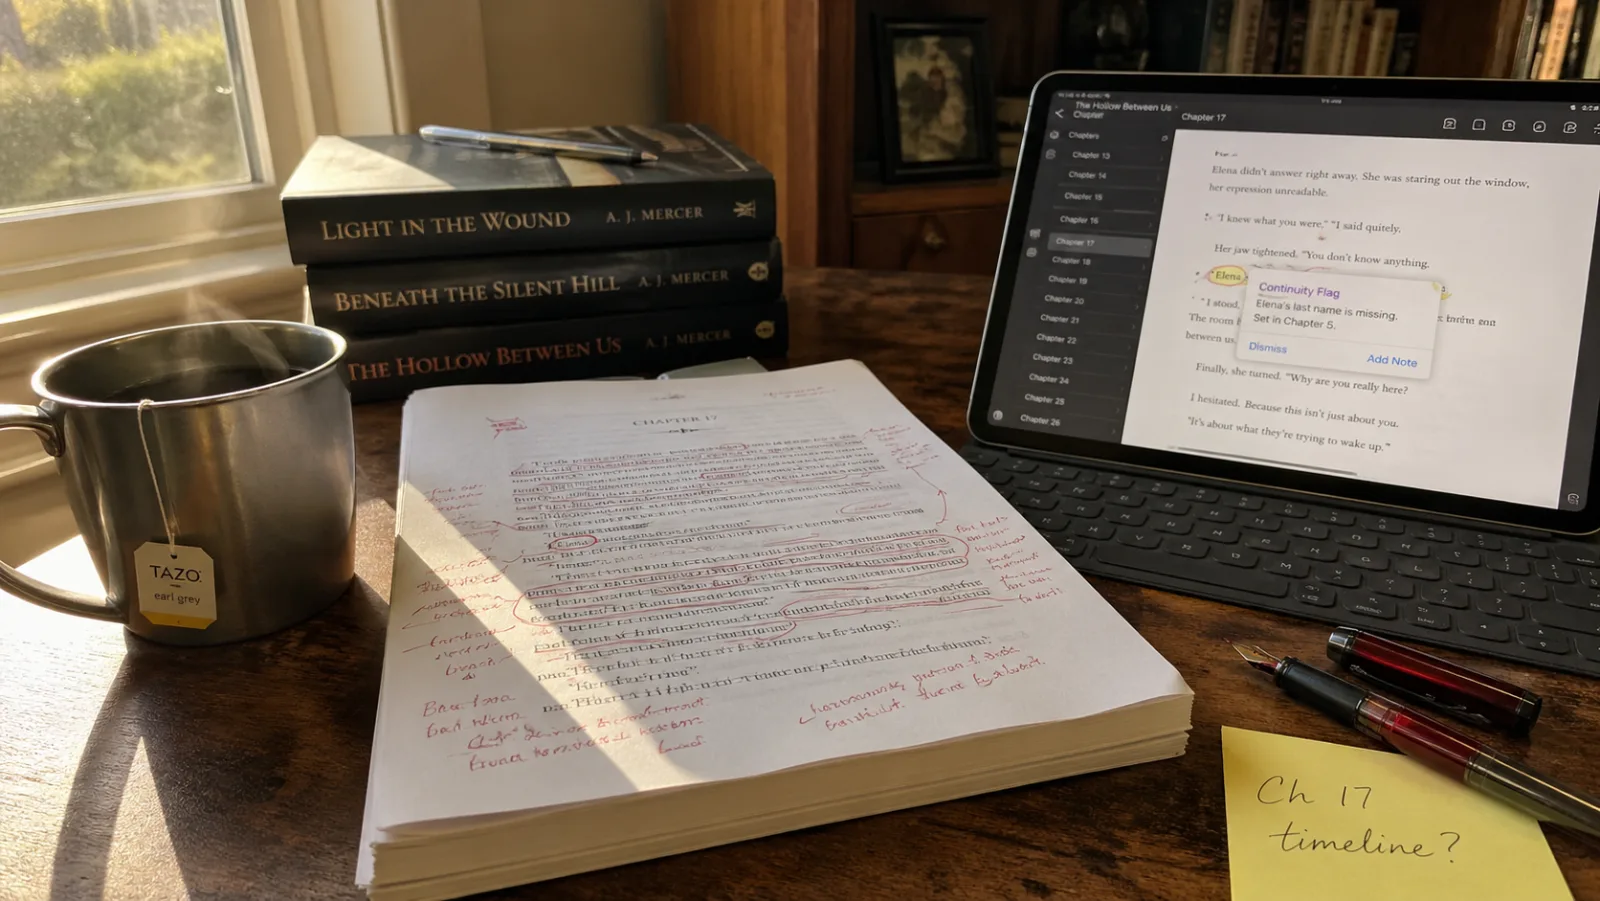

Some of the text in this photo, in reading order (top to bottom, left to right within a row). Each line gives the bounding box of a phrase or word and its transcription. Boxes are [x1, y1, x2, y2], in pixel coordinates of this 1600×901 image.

[1075, 101, 1091, 109] The
[1122, 102, 1158, 112] Between
[1160, 104, 1172, 112] Us
[1181, 113, 1227, 122] Chapter 17
[1212, 165, 1238, 176] Elena
[1240, 166, 1267, 177] didn't
[1269, 170, 1302, 178] answer
[1305, 171, 1329, 180] right
[1332, 174, 1358, 182] away.
[1362, 172, 1380, 182] She
[1405, 175, 1440, 186] staring
[1443, 178, 1461, 186] out
[1464, 176, 1481, 186] the
[1484, 178, 1530, 188] window,
[1208, 183, 1224, 192] her
[1274, 187, 1328, 197] unreadable.
[606, 206, 704, 225] A. J. MERCER
[320, 210, 572, 241] LIGHT IN THE WOUND
[1226, 214, 1252, 224] knew
[1254, 216, 1276, 226] what
[1278, 220, 1296, 228] you
[1343, 222, 1363, 232] said
[1365, 222, 1402, 234] quitely.
[1087, 239, 1095, 247] 17
[1214, 244, 1232, 254] Her
[1233, 246, 1250, 256] jaw
[1252, 248, 1299, 259] tightened.
[1326, 252, 1352, 263] don't
[1354, 254, 1381, 264] know
[1384, 258, 1430, 270] anything.
[638, 270, 730, 288] A. J. MERCER
[334, 274, 621, 312] BENEATH THE SILENT HILL
[1258, 282, 1340, 300] Continuity Flag
[1044, 294, 1073, 304] Chapter
[1256, 299, 1398, 322] Elena's last name is missing.
[1040, 314, 1080, 324] Chapter 21
[1188, 312, 1208, 322] The
[1208, 316, 1234, 326] room
[1253, 313, 1270, 324] Set
[1272, 315, 1282, 325] in
[1283, 316, 1324, 330] Chapter
[1326, 320, 1337, 330] 5.
[676, 329, 732, 346] MERCER
[1036, 333, 1077, 344] Chapter 22
[1185, 330, 1222, 343] between
[1248, 341, 1288, 354] Dismiss
[348, 336, 622, 382] THE HOLLOW BETWEEN US
[1032, 353, 1074, 364] Chapter 23
[1366, 354, 1418, 368] Add Note
[1028, 373, 1070, 384] Chapter 24
[1196, 362, 1228, 376] Finally,
[1231, 366, 1247, 377] she
[1248, 370, 1282, 381] turned.
[1315, 378, 1331, 386] are
[1332, 380, 1350, 389] you
[1352, 382, 1380, 394] really
[1382, 384, 1408, 395] here?
[1024, 394, 1066, 406] Chapter 25
[1190, 392, 1399, 428] I hesitated. Because this isn't just about you.
[632, 416, 700, 426] CHAPTER
[1020, 414, 1061, 427] Chapter 26
[1206, 420, 1234, 431] about
[1236, 424, 1259, 435] what
[1261, 426, 1294, 440] they're
[1296, 432, 1326, 446] trying
[1328, 436, 1338, 446] to
[1340, 440, 1366, 450] wake
[149, 564, 200, 582] TAZO
[154, 592, 201, 606] earl grey
[1256, 774, 1373, 810] Ch 17
